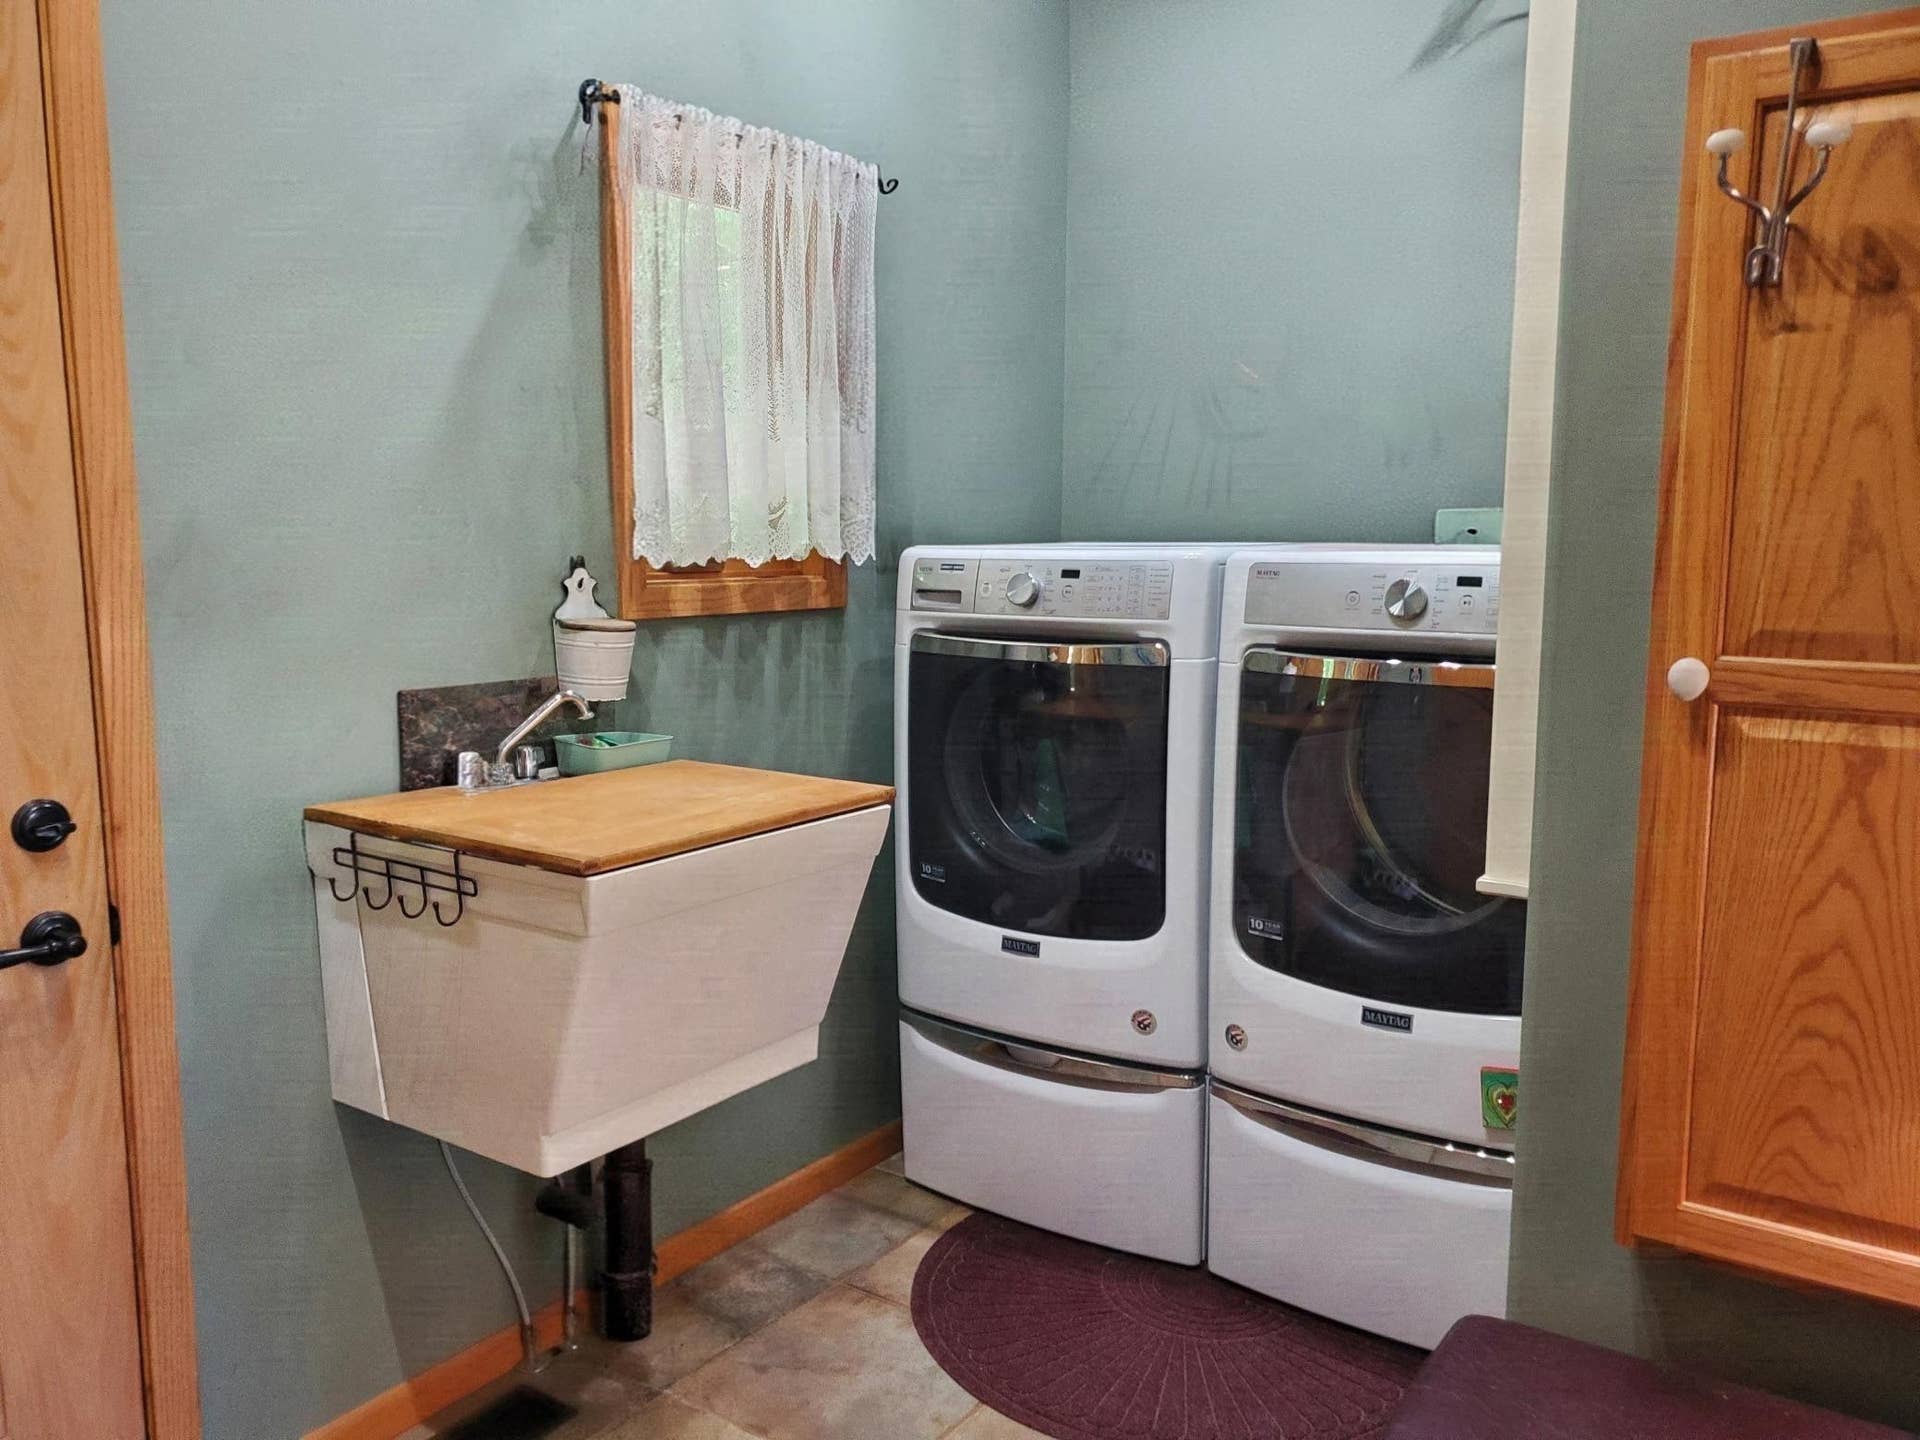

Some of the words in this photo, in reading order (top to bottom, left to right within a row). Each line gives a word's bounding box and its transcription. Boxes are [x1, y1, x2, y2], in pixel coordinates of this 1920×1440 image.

[921, 863, 932, 873] 10
[1250, 918, 1264, 930] 10
[1003, 938, 1039, 955] MAYTAG
[1363, 1010, 1410, 1028] MAYTAG
